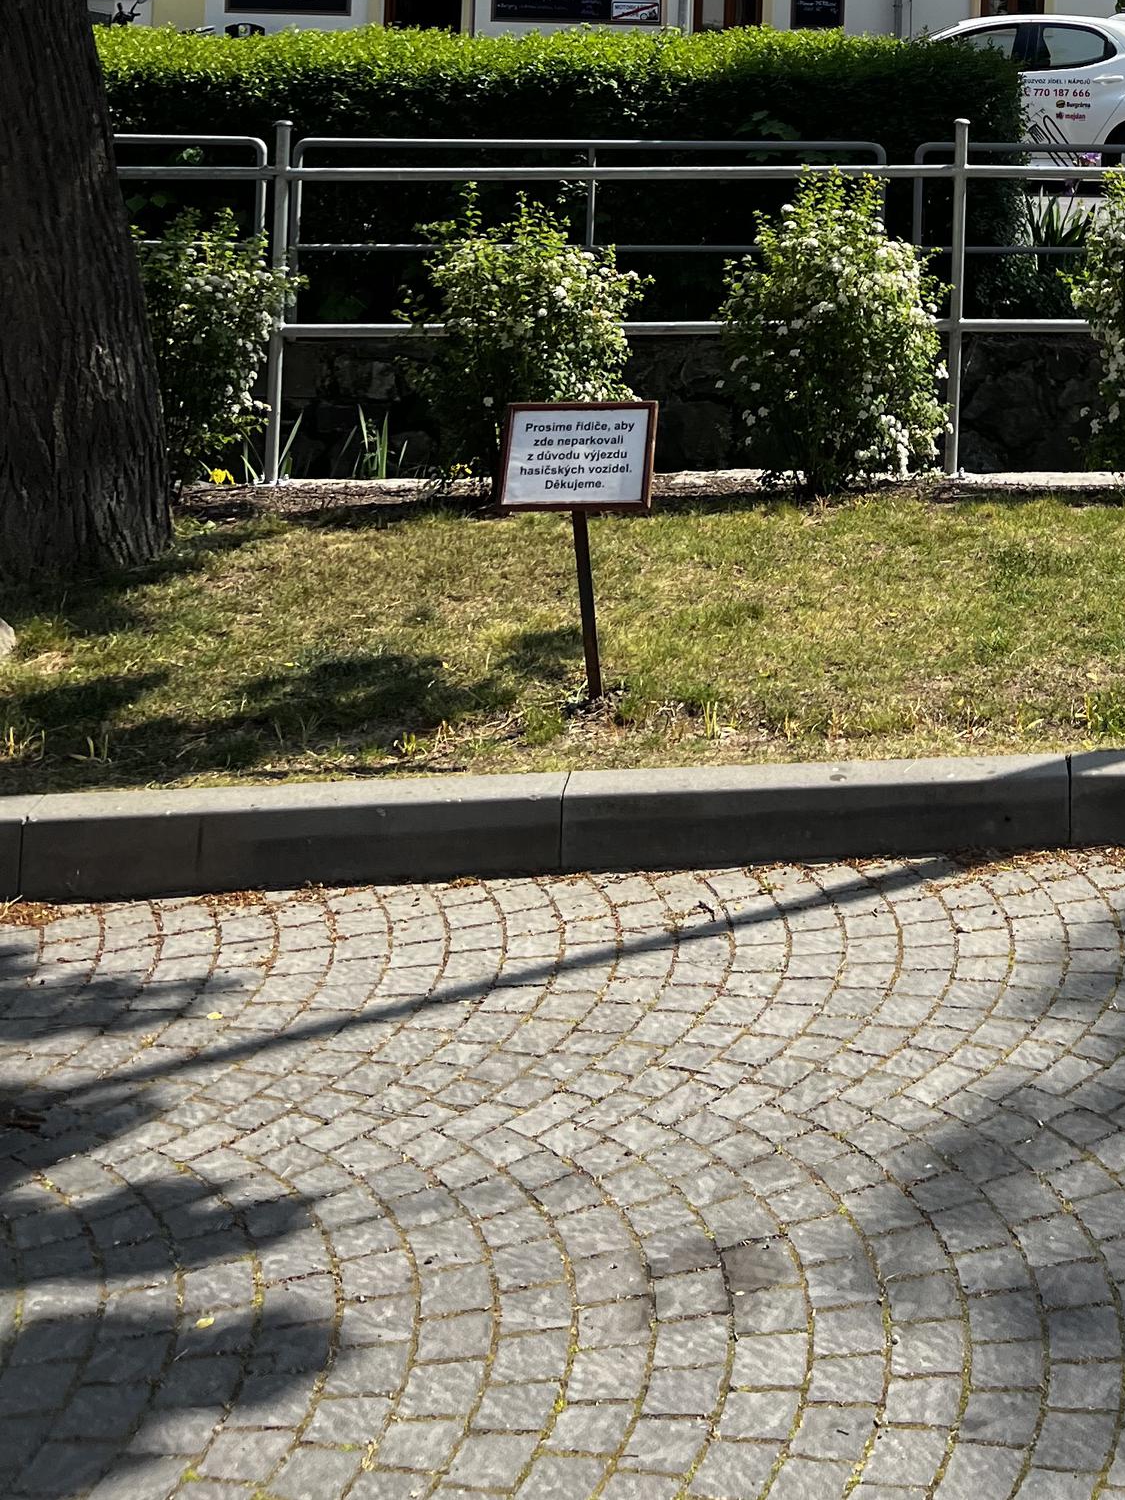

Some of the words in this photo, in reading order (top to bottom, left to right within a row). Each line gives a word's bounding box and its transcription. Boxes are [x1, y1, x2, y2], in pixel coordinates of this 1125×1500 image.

[1034, 88, 1050, 97] 770
[1053, 89, 1069, 97] 187
[1073, 89, 1091, 97] 666
[614, 421, 635, 432] aby
[533, 437, 554, 446] zde
[557, 435, 624, 447] neparkovali
[527, 453, 533, 461] z
[584, 449, 628, 462] výjezdu
[520, 465, 585, 477] hasičských
[589, 464, 632, 474] vozidel.
[545, 479, 605, 491] Děkujeme.
